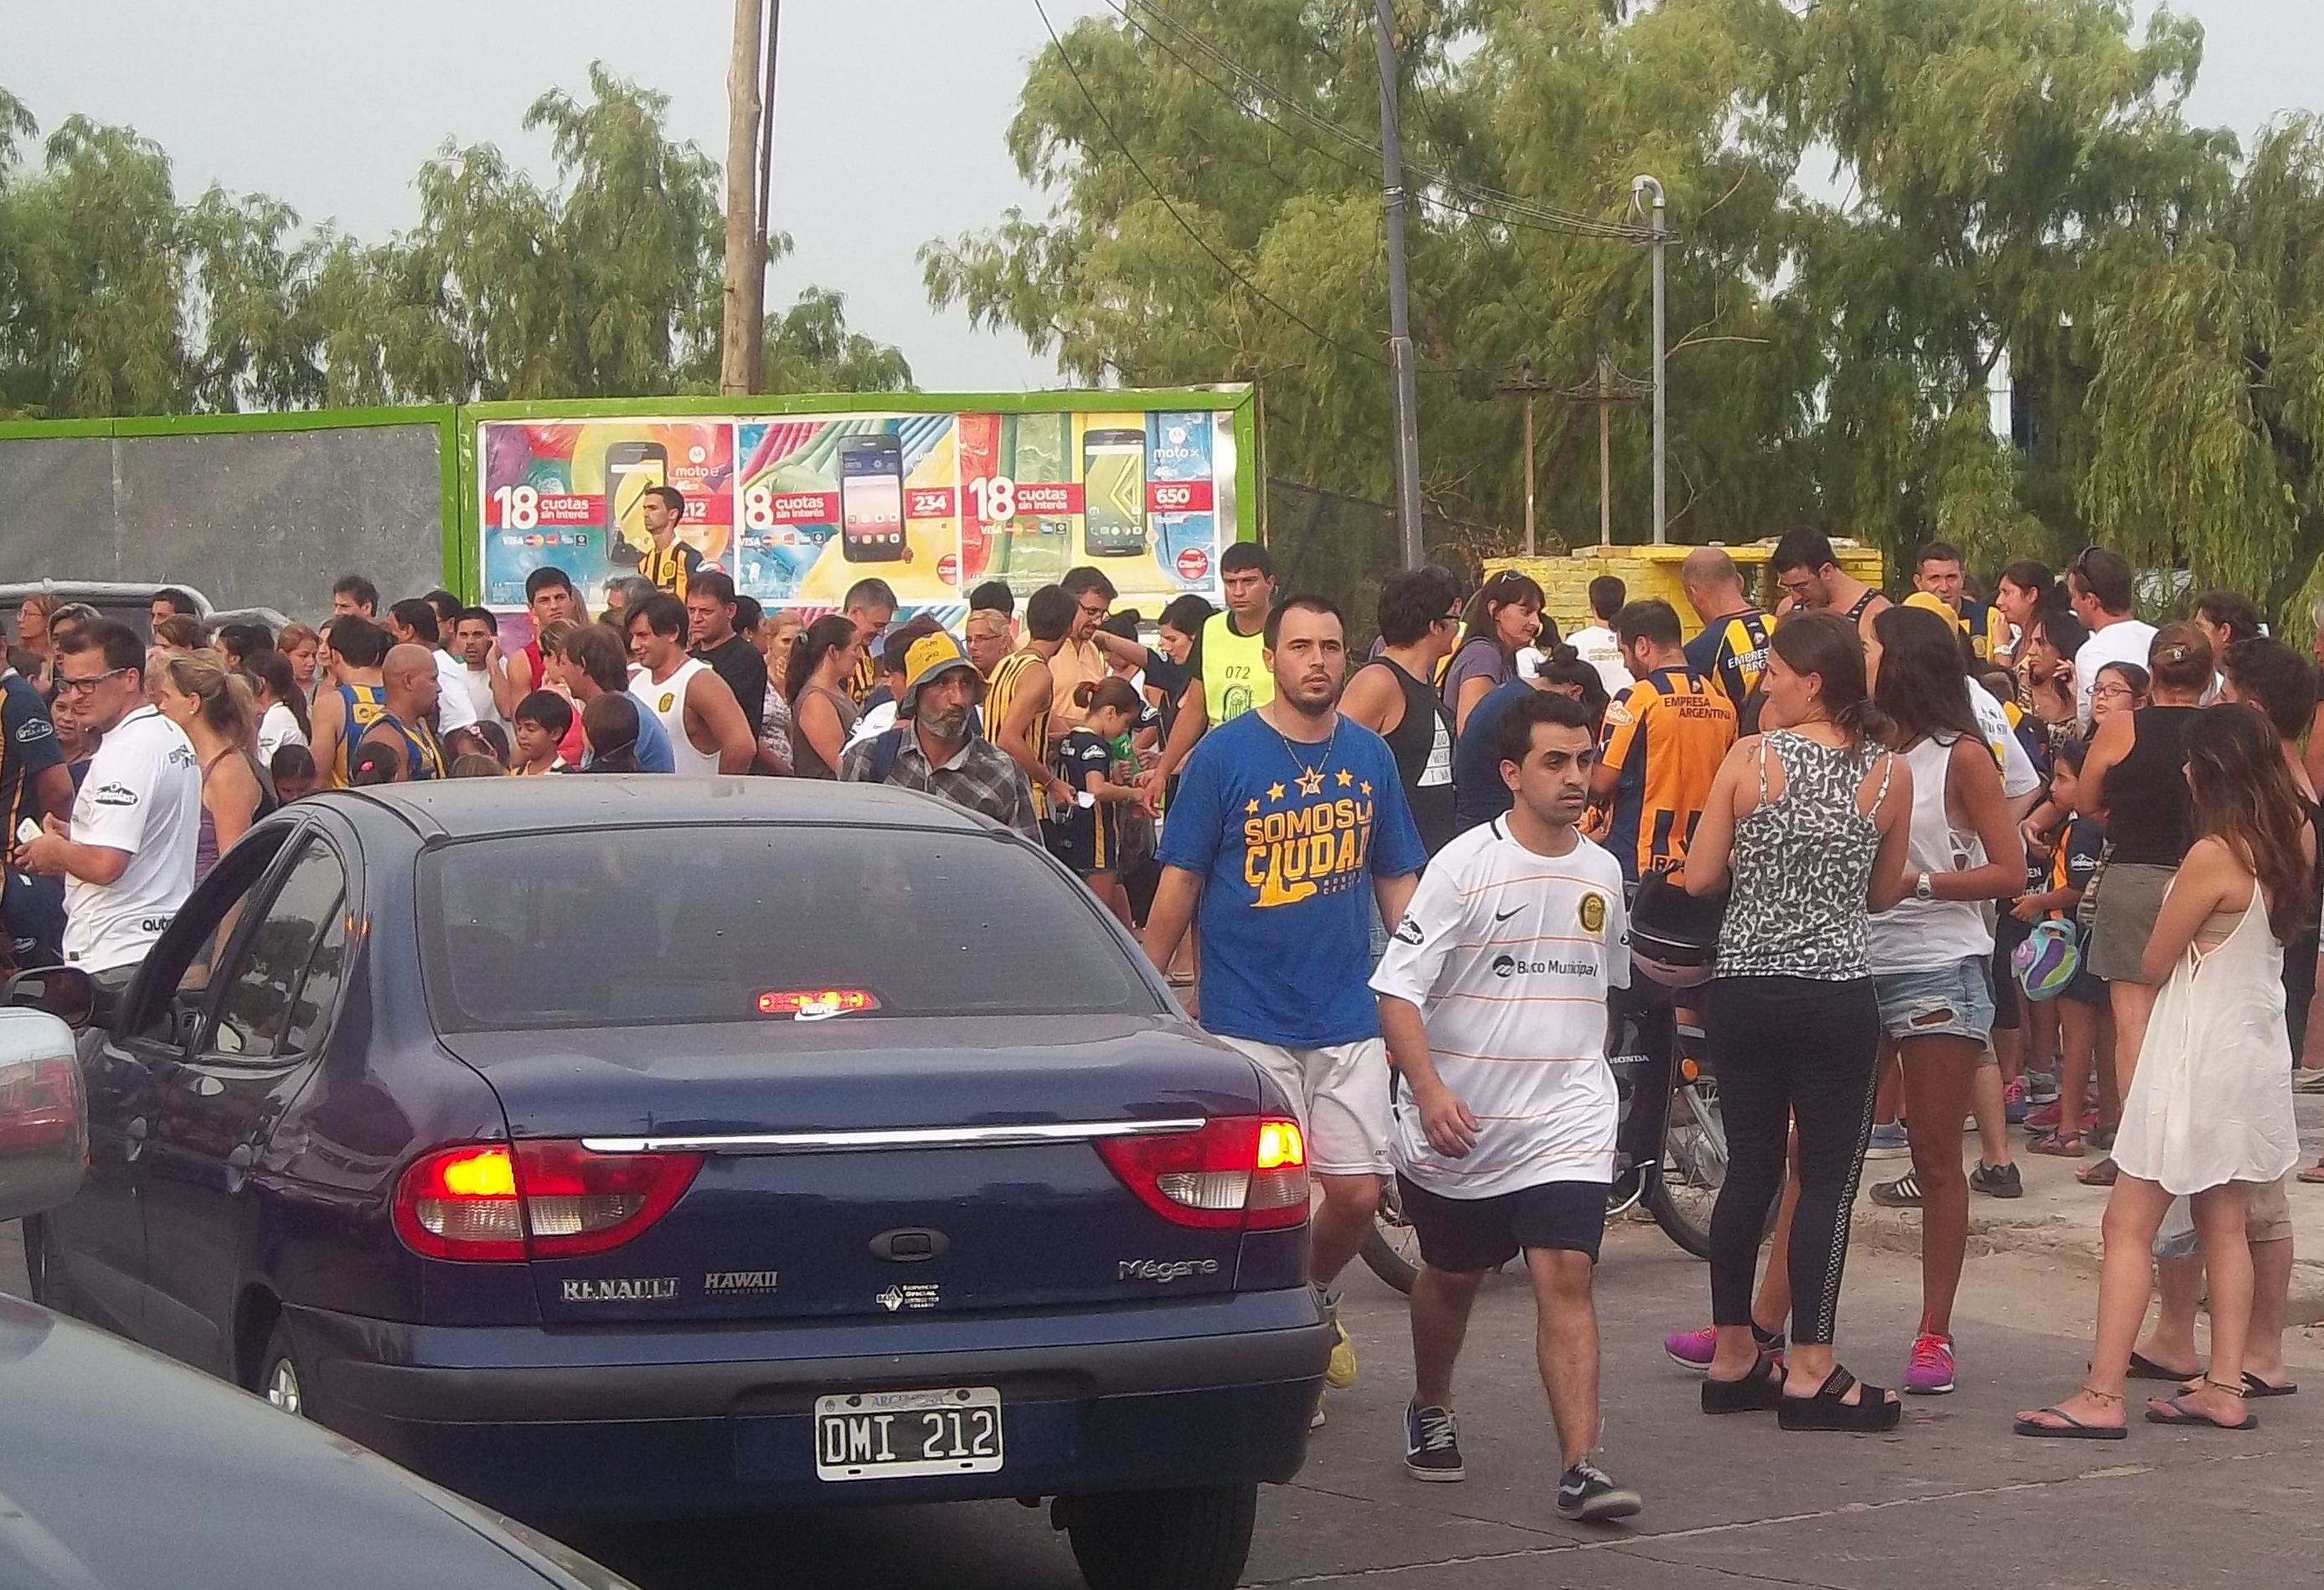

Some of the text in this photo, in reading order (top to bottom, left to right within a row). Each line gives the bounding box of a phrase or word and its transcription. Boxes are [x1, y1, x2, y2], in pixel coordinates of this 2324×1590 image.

[1153, 446, 1188, 458] moto
[675, 466, 709, 476] moto
[969, 476, 1016, 521] 18
[1018, 488, 1068, 500] cuotas
[1156, 488, 1190, 504] 650
[493, 486, 538, 529] 18
[540, 498, 589, 510] cuotas
[775, 496, 825, 509] cuotas
[914, 495, 947, 511] 234
[1018, 502, 1033, 510] sin
[540, 510, 554, 519] sin
[776, 510, 791, 519] sin
[1225, 666, 1250, 679] 072
[1664, 696, 1711, 708] EMPRESA
[1244, 799, 1355, 846] SOMOS
[1610, 1054, 1650, 1064] HONDA
[704, 1271, 777, 1289] HAWAII
[561, 1279, 678, 1299] RENAULT
[824, 1410, 994, 1464] DMI 212
